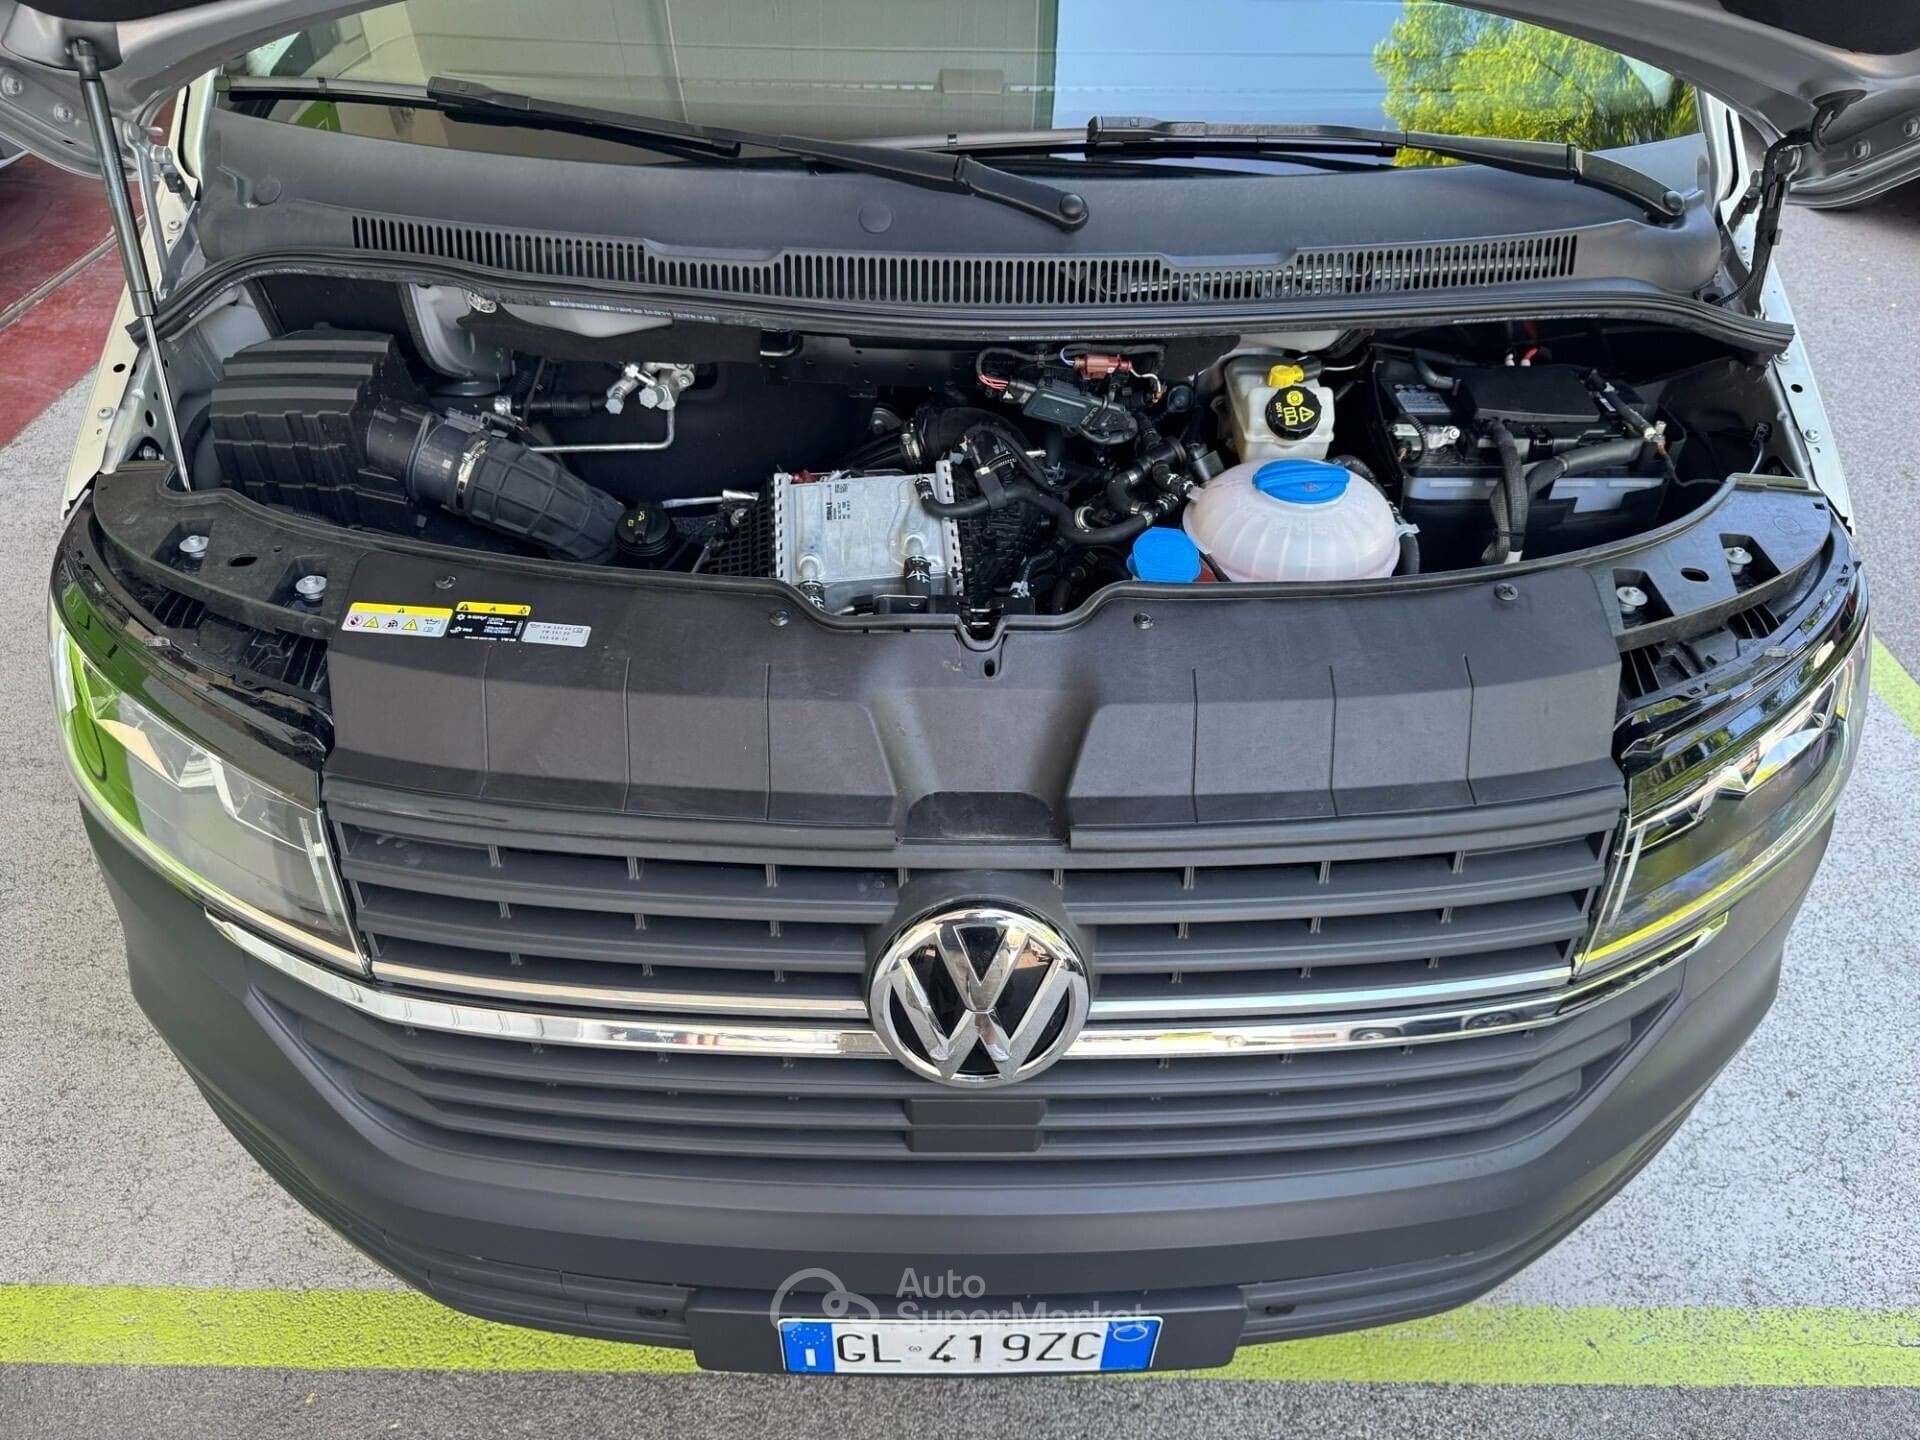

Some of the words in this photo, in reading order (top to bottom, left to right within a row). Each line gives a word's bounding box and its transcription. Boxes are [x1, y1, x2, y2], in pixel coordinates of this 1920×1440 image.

[876, 912, 1085, 1086] VW
[836, 1333, 902, 1363] GL
[929, 1331, 1102, 1363] 419ZC
